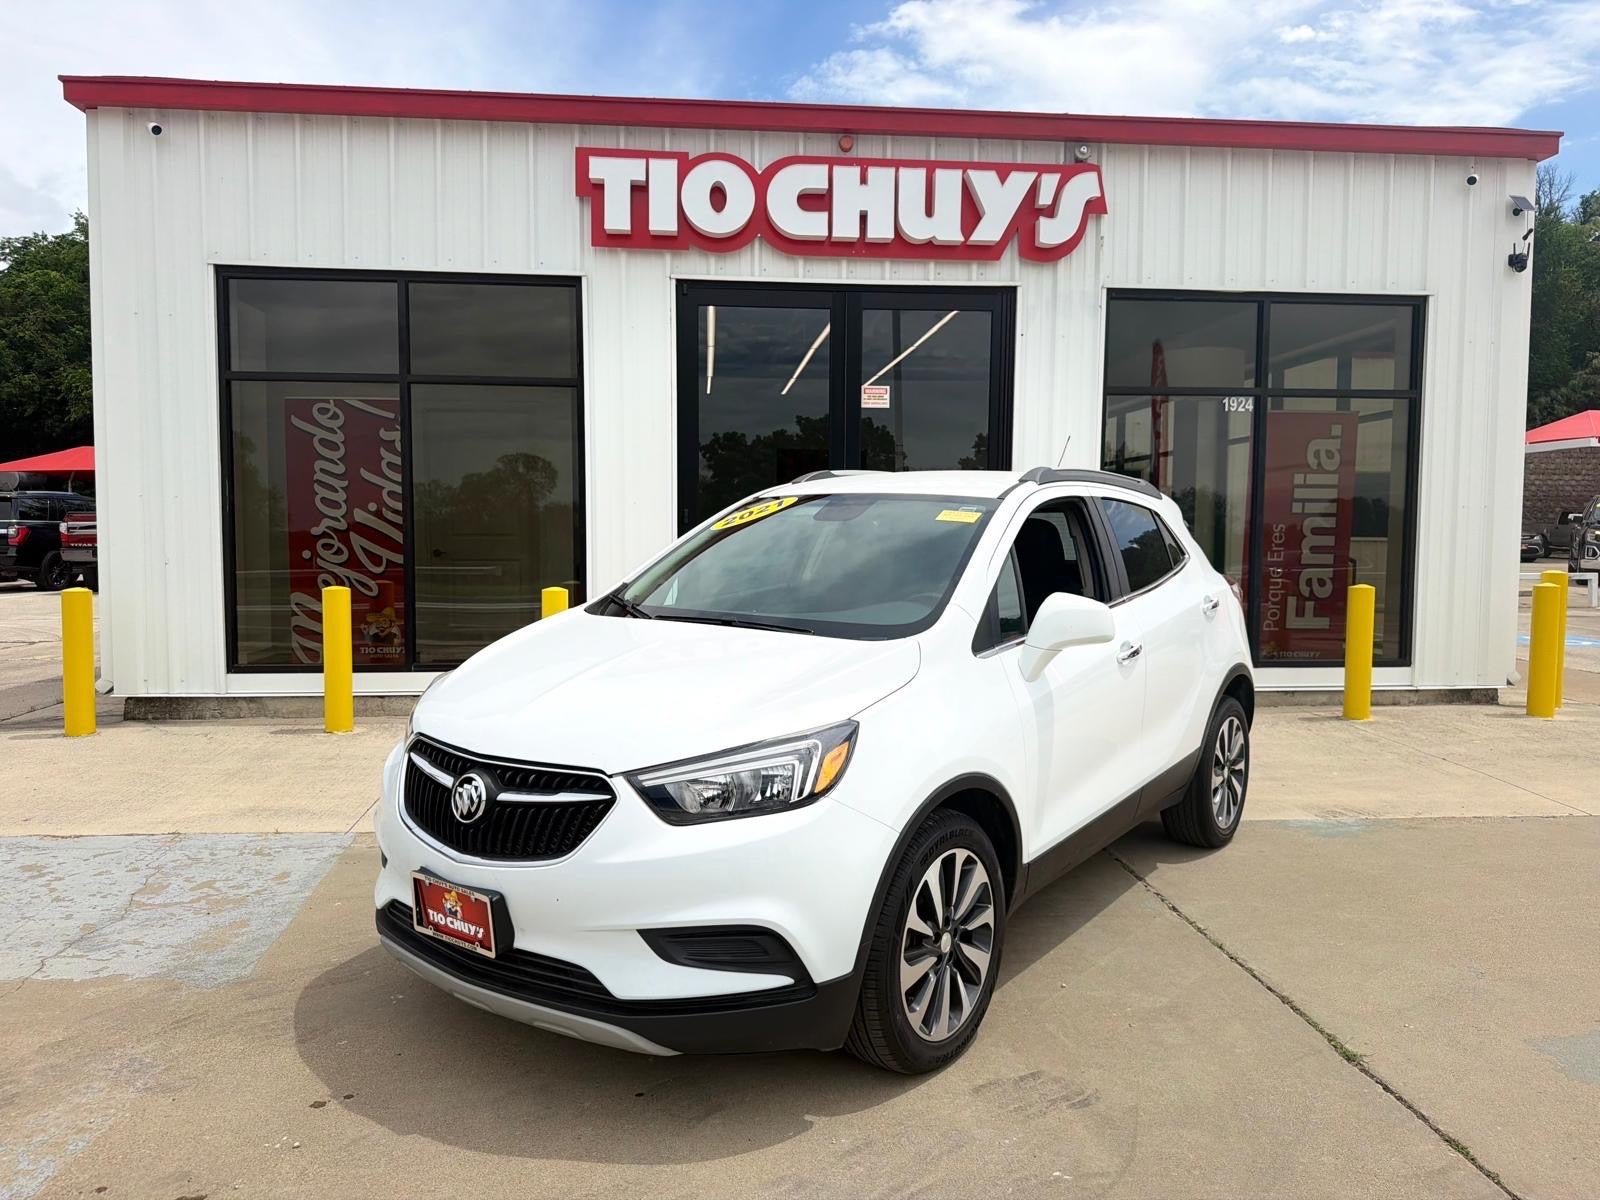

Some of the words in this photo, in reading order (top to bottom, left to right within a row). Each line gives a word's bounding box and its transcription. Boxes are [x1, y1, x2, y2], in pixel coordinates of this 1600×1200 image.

[588, 155, 757, 240] TIO
[766, 162, 1103, 249] CHUY'S
[1222, 396, 1254, 412] 1924
[290, 399, 379, 664] Mejorando
[721, 500, 785, 528] 2021
[1285, 424, 1343, 630] Familia.
[1267, 523, 1286, 562] Eres
[1263, 567, 1290, 632] Porque
[427, 908, 446, 926] TIO
[446, 916, 485, 939] CHUY'S
